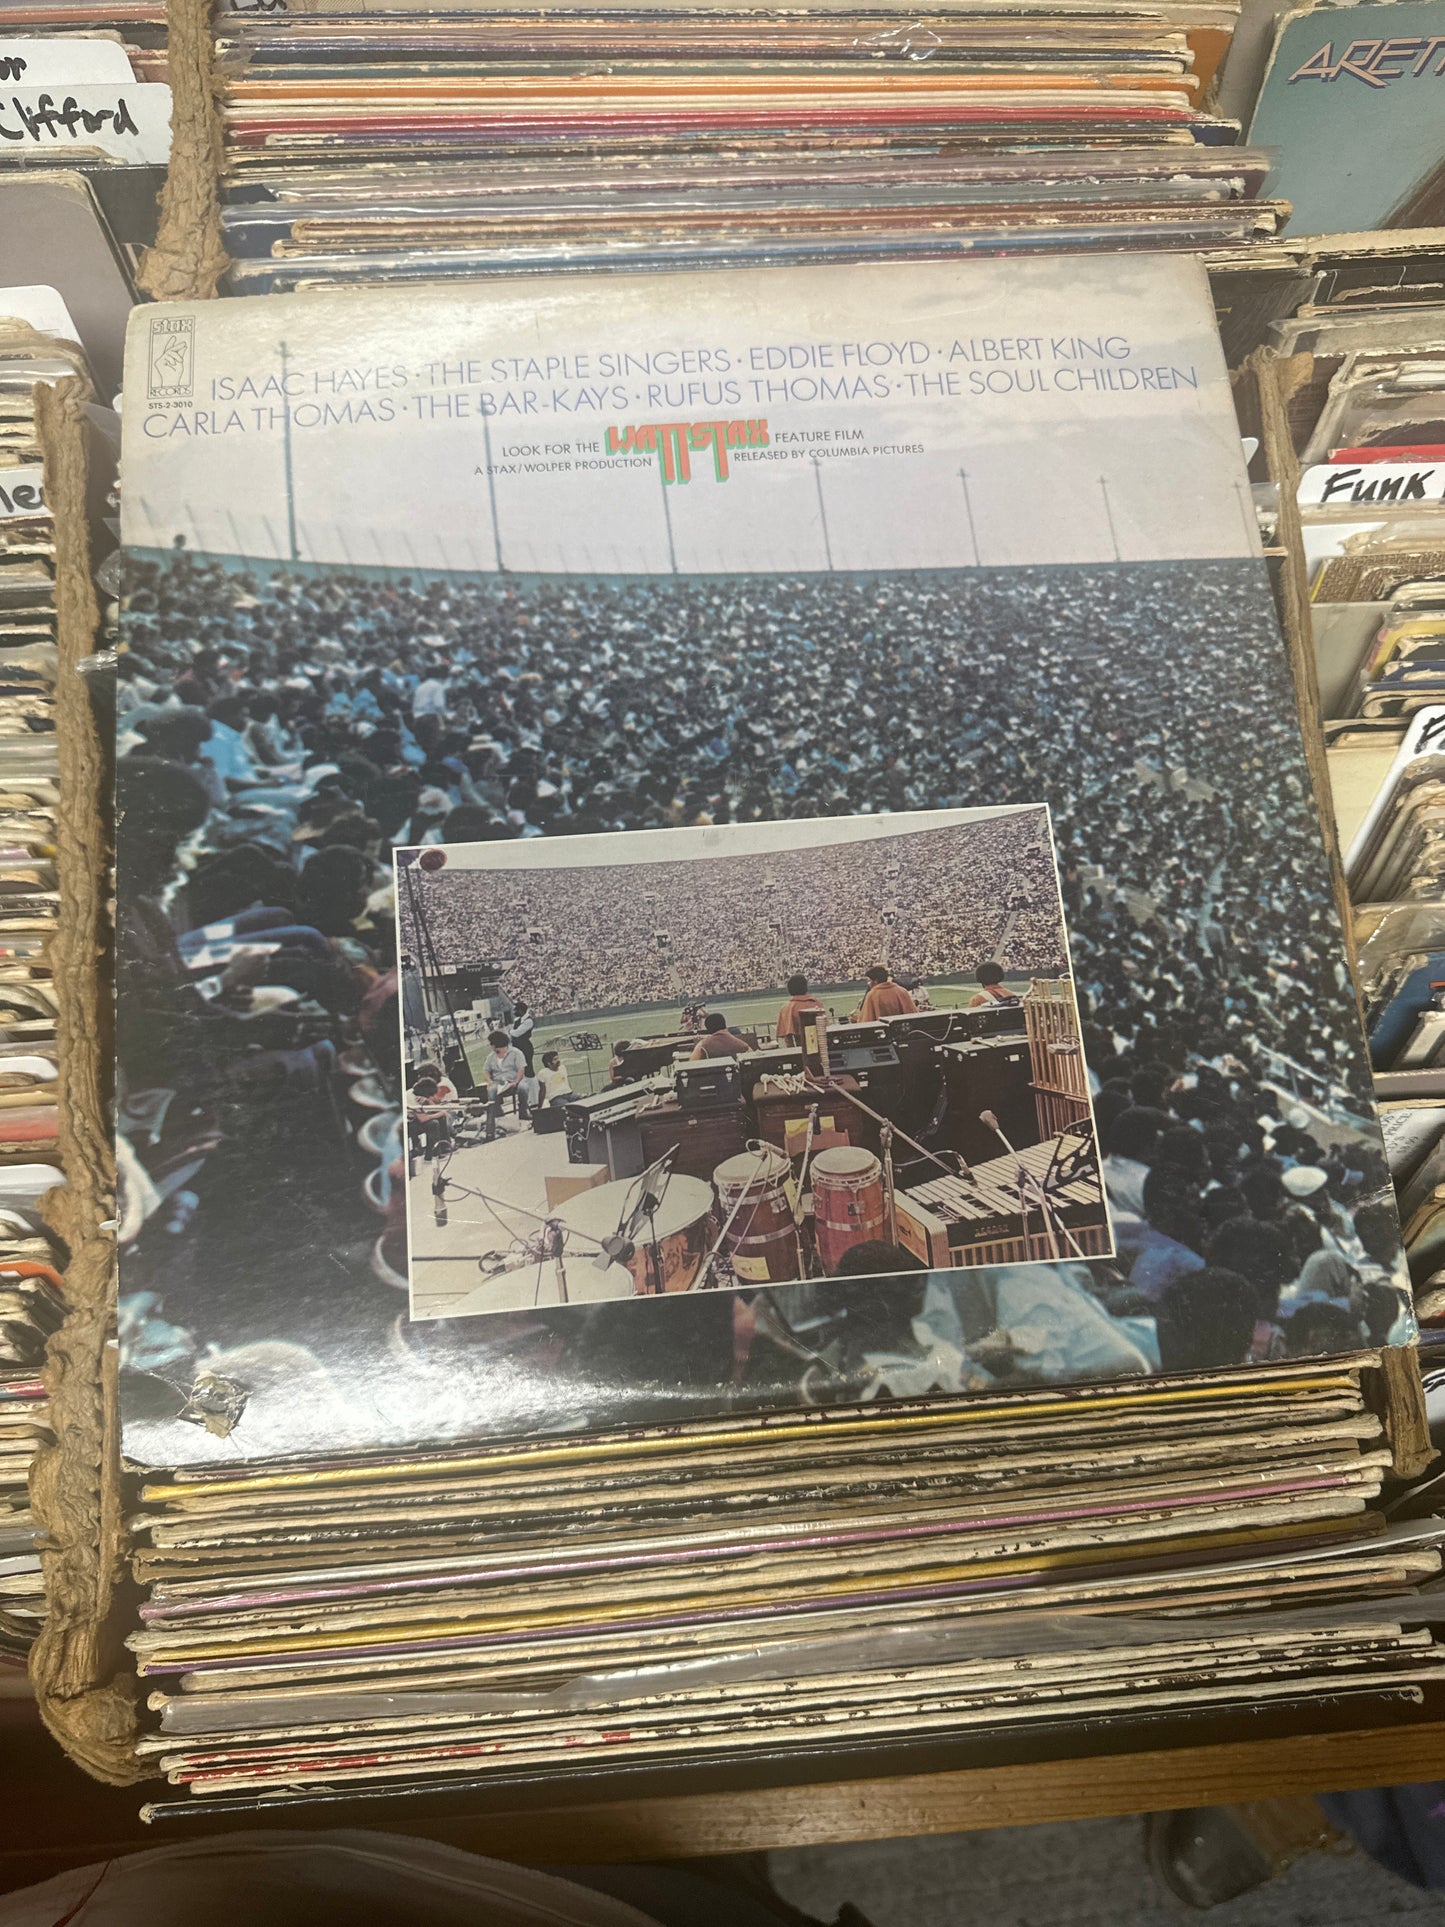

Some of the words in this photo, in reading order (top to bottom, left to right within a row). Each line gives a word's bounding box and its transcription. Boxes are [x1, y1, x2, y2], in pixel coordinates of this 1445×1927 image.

[1287, 36, 1445, 88] ARET
[212, 373, 306, 401] ISAAC
[314, 364, 408, 395] HAYES
[425, 360, 482, 385] THE
[491, 356, 590, 384] STAPLE
[599, 349, 731, 377] SINGERS
[749, 344, 834, 371] EDDIE
[842, 341, 931, 367] FLOYD
[949, 337, 1045, 363] ALBERT
[1050, 336, 1131, 361] KING
[143, 408, 246, 438] CARLA
[250, 398, 396, 431] THOMAS
[411, 394, 470, 419] THE
[480, 385, 629, 417] BAR-KAYS
[648, 380, 741, 408] RUFUS
[750, 374, 891, 404] THOMAS
[904, 372, 962, 397] THE
[968, 369, 1050, 395] SOUL
[1054, 366, 1199, 393] CHILDREN
[148, 401, 193, 410] STS-2-3010
[474, 466, 484, 476] A
[487, 461, 572, 475] STAX/WOLPER
[575, 458, 652, 471] PRODUCTION
[733, 450, 788, 462] RELEASED
[791, 449, 806, 460] BY
[808, 446, 870, 458] COLUMBIA
[872, 444, 924, 456] PICTURES
[502, 445, 540, 458] LOOK
[545, 443, 571, 456] FOR
[576, 442, 600, 454] THE
[605, 418, 771, 486] WATTSTAX
[774, 431, 831, 443] FEATURE
[834, 430, 864, 441] FILM
